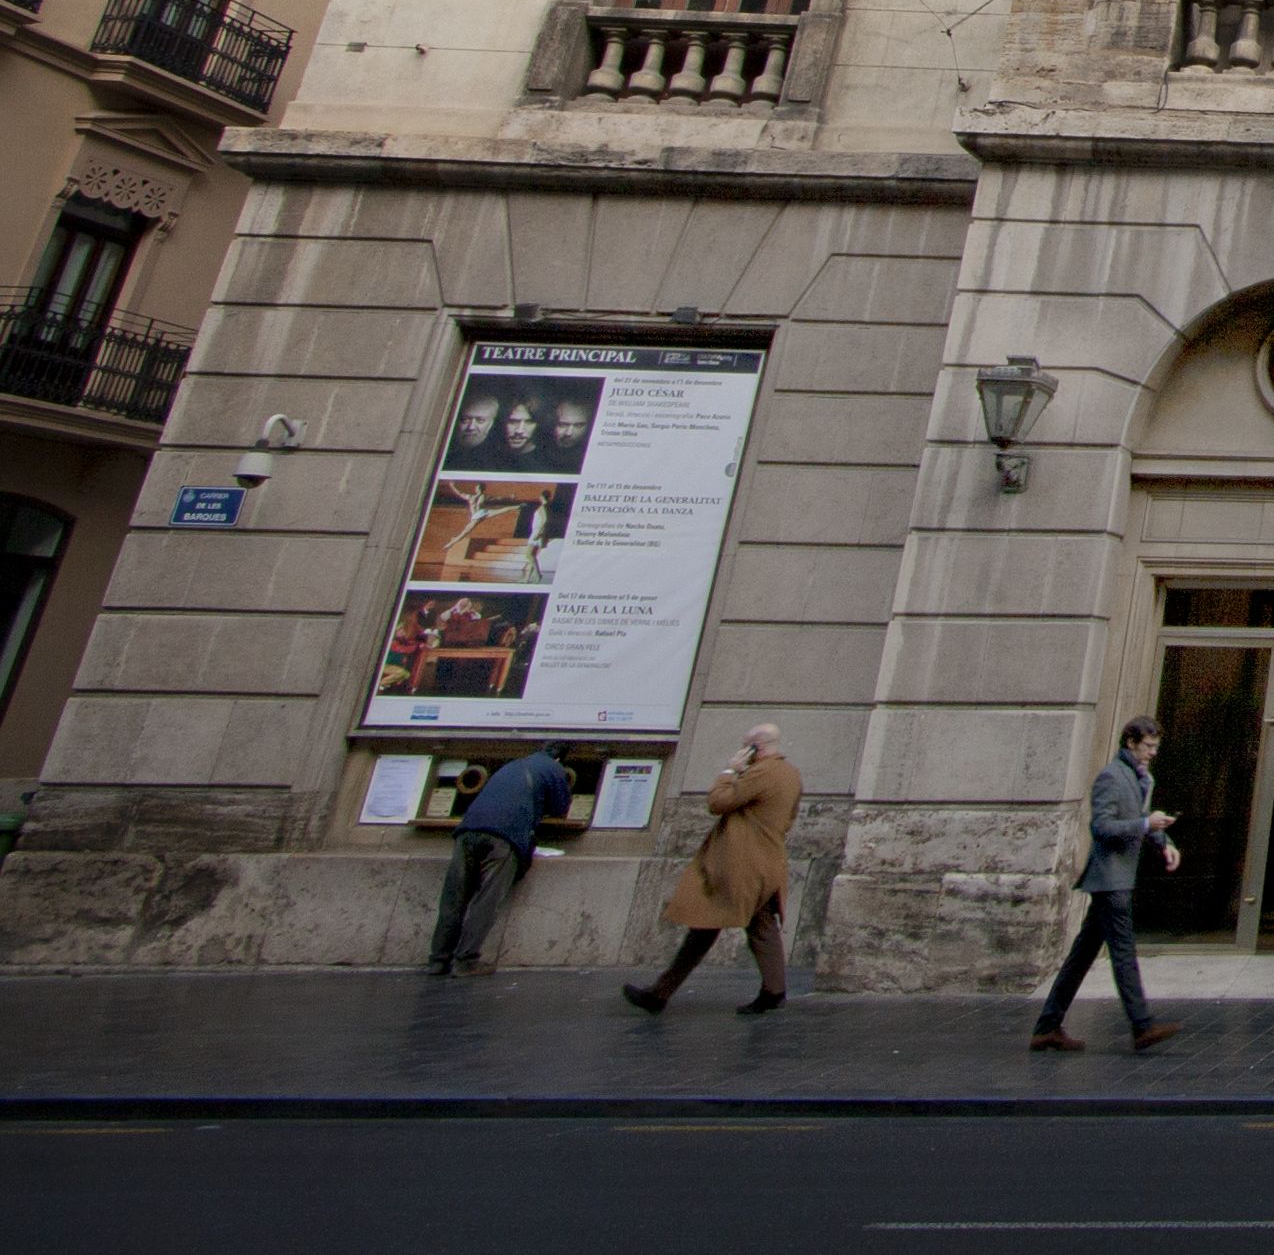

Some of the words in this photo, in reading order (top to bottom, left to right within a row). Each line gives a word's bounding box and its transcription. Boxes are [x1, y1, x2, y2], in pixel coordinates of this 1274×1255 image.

[482, 346, 546, 360] TEATRE
[550, 348, 637, 363] PRINCIPAL
[609, 388, 644, 398] JULIO
[648, 387, 685, 398] CÉSAR
[655, 497, 722, 505] GENERALITAT
[581, 505, 637, 514] INVITACIÓN
[184, 513, 226, 521] BARQUES
[556, 605, 588, 615] VIAJE
[590, 605, 598, 614] A
[603, 605, 617, 614] LA
[621, 606, 653, 615] LUNA
